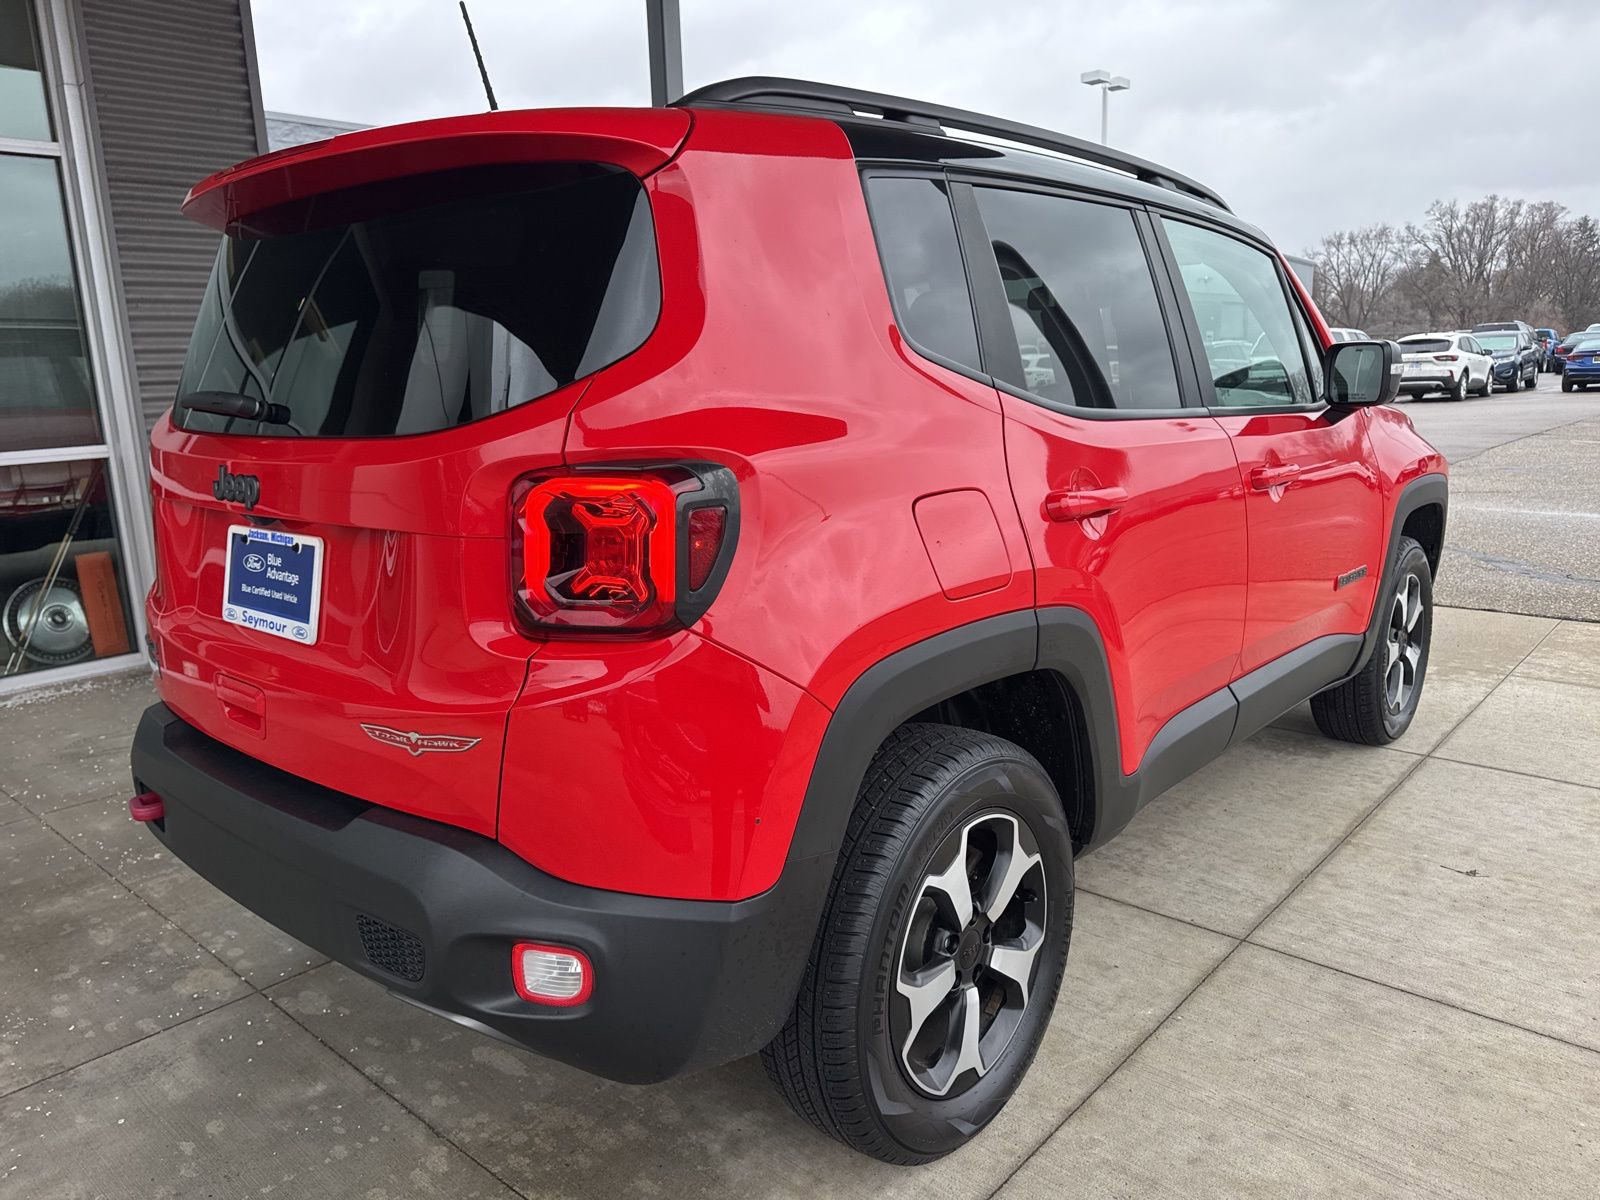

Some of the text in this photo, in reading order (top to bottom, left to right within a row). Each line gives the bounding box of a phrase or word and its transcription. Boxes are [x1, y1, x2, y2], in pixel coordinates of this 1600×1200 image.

[213, 464, 260, 511] Jeep
[270, 532, 294, 546] Michigan
[267, 553, 282, 567] Blue
[266, 569, 300, 586] Advantage
[241, 583, 298, 604] Blue Certified Used Vehicle
[242, 610, 287, 634] Seymour
